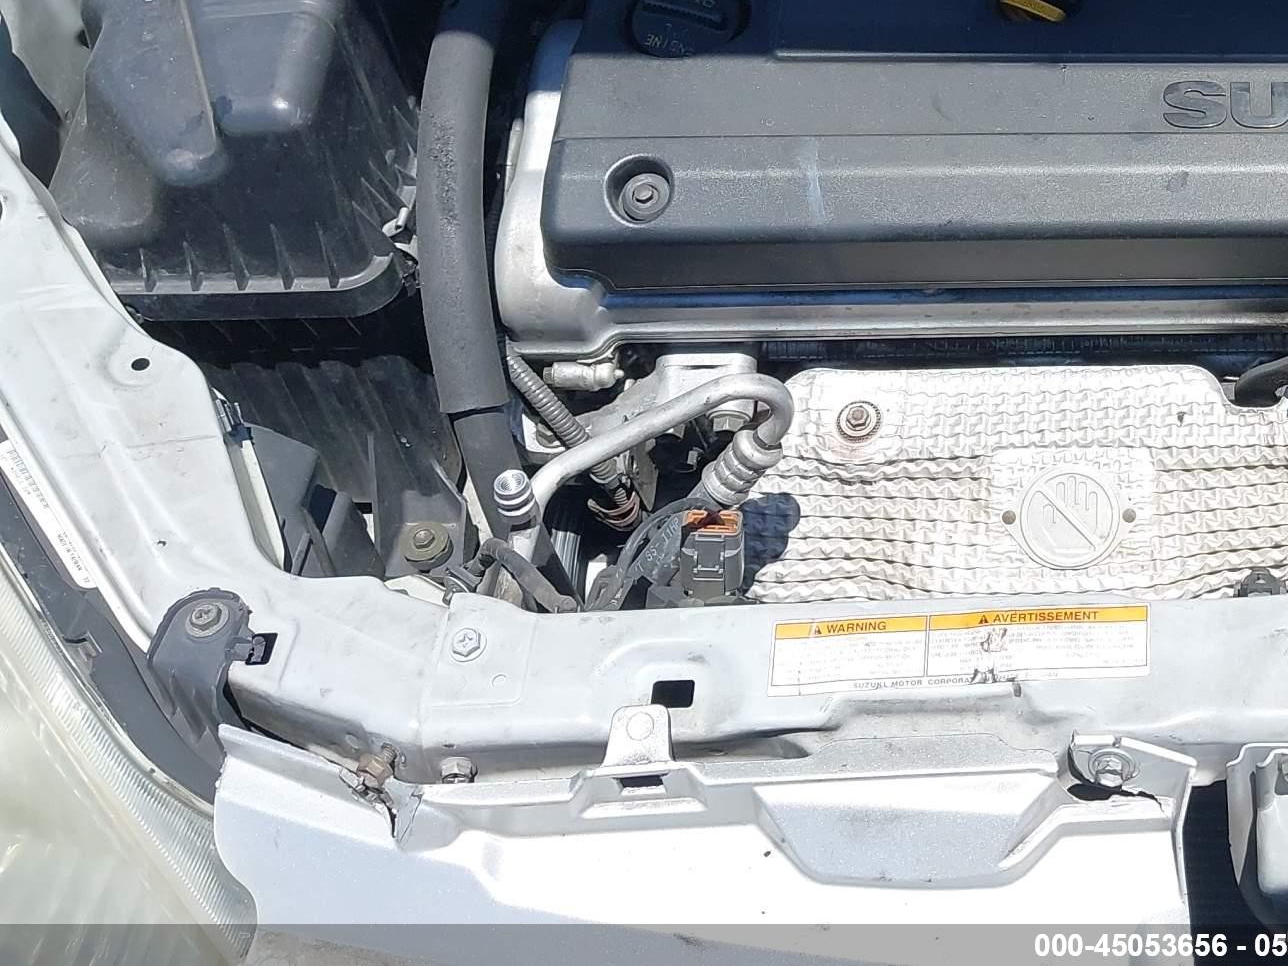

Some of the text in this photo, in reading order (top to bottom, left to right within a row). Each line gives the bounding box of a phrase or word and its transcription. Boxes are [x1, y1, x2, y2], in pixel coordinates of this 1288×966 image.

[993, 610, 1099, 624] AVERTISSEMENT
[826, 621, 887, 634] WARNING
[891, 679, 923, 689] MOTOR
